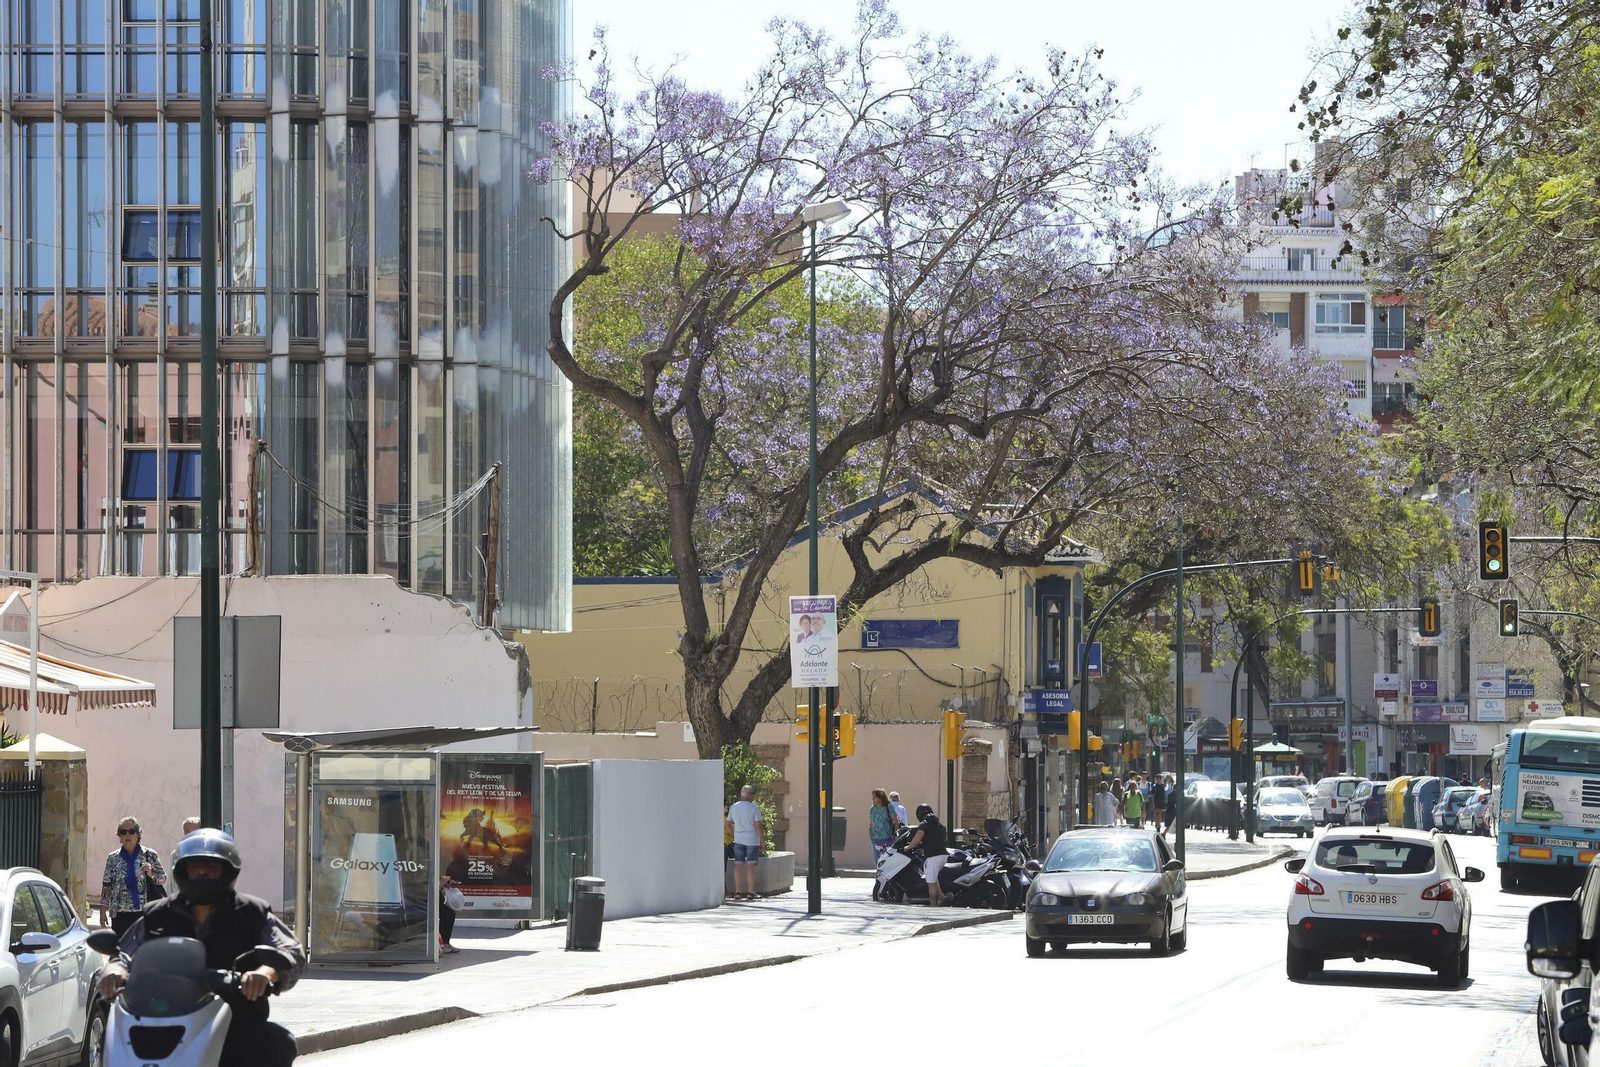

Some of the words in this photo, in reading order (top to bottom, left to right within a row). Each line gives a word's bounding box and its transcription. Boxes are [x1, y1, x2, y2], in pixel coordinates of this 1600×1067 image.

[327, 797, 372, 806] SAMSUNG
[330, 858, 390, 874] Galaxy
[394, 860, 424, 872] S10+
[468, 861, 494, 872] 25%
[1354, 894, 1376, 903] 0630
[1380, 895, 1397, 904] HBS
